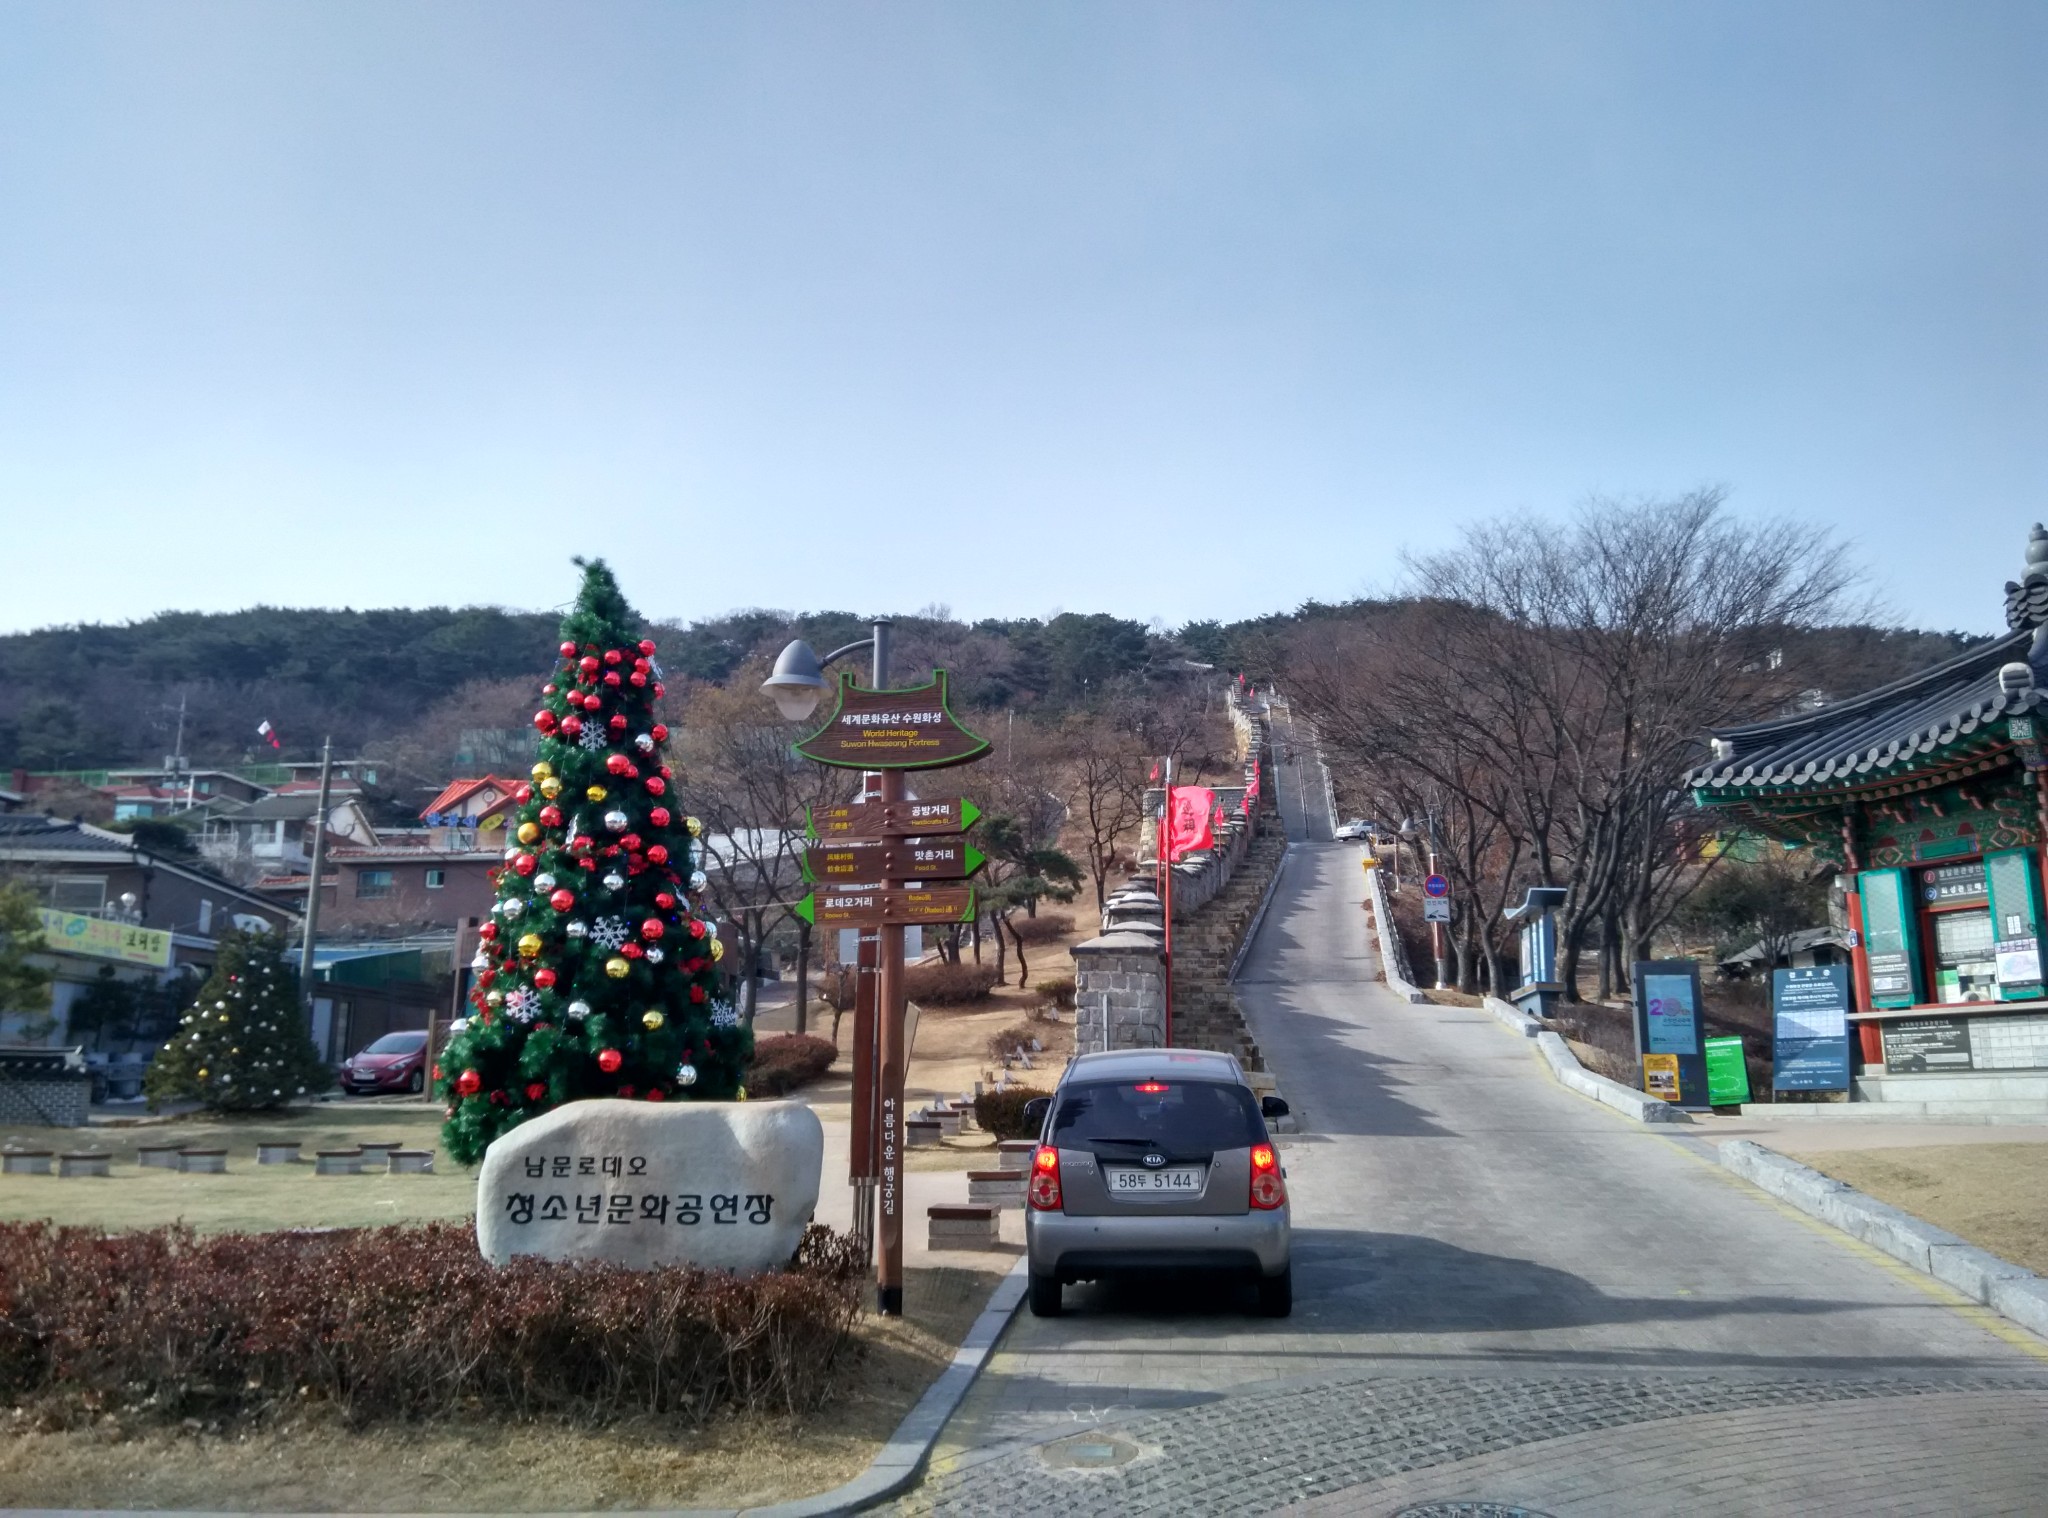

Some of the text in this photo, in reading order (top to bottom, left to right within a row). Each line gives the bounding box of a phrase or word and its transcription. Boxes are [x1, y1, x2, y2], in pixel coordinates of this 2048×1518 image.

[841, 712, 942, 725] 세계문화유산 수원화성
[862, 729, 919, 738] World Heritage
[841, 739, 940, 749] Suwon Hwaseong Fortress
[912, 804, 950, 817] 공방거리
[915, 849, 954, 861] 맛촌거리
[825, 897, 873, 908] 로데오거리
[883, 1098, 896, 1215] 아름다운 행궁길
[1146, 1155, 1162, 1164] KIA
[525, 1156, 648, 1178] 남문로데오
[1119, 1173, 1192, 1188] 58두 5144
[505, 1193, 775, 1225] 청소년문화공연장
